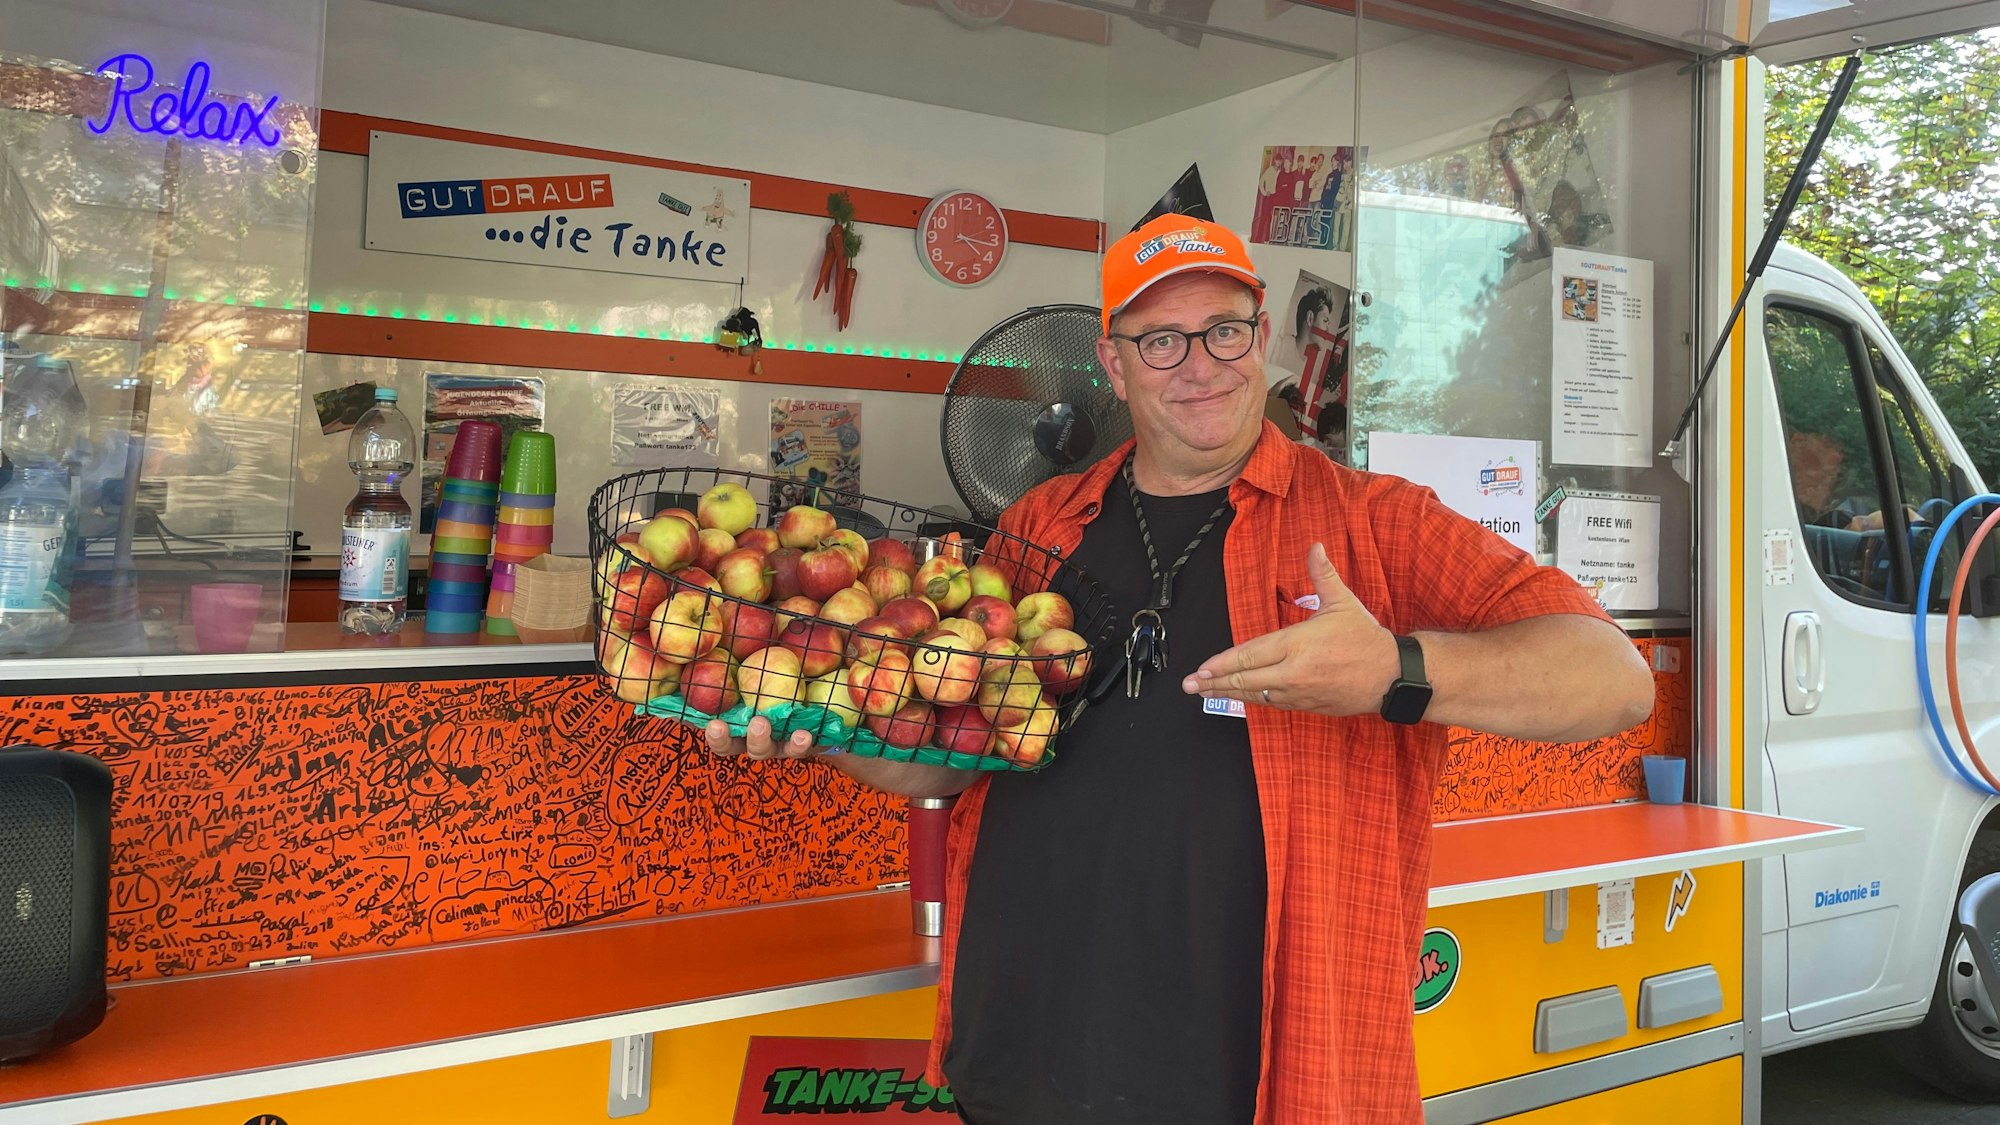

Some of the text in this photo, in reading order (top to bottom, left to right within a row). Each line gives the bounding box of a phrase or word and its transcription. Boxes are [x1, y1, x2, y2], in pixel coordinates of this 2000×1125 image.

[87, 53, 281, 147] Relax
[406, 180, 606, 211] GUT DRAUF
[943, 203, 955, 215] 11
[957, 198, 972, 211] 12
[976, 203, 982, 215] 1
[932, 216, 947, 229] 10
[985, 216, 995, 229] 2
[1269, 206, 1333, 247] BTS
[927, 230, 938, 243] 9
[990, 234, 999, 246] 3
[604, 222, 727, 267] Tanke
[1139, 231, 1201, 260] GUT DRAUF
[1173, 240, 1225, 255] Tanke
[932, 248, 942, 262] 8
[982, 250, 993, 264] 4
[944, 261, 954, 273] 7
[957, 267, 967, 280] 6
[972, 263, 982, 275] 5
[1481, 469, 1519, 482] GUT DRAUF
[1536, 490, 1565, 518] TANKE GUT
[1475, 517, 1520, 533] tation
[1587, 516, 1632, 530] FREE Wifi
[1580, 559, 1635, 569] Netzname: tanke
[1207, 698, 1245, 712] GUT DR
[1814, 884, 1868, 909] Diakonie
